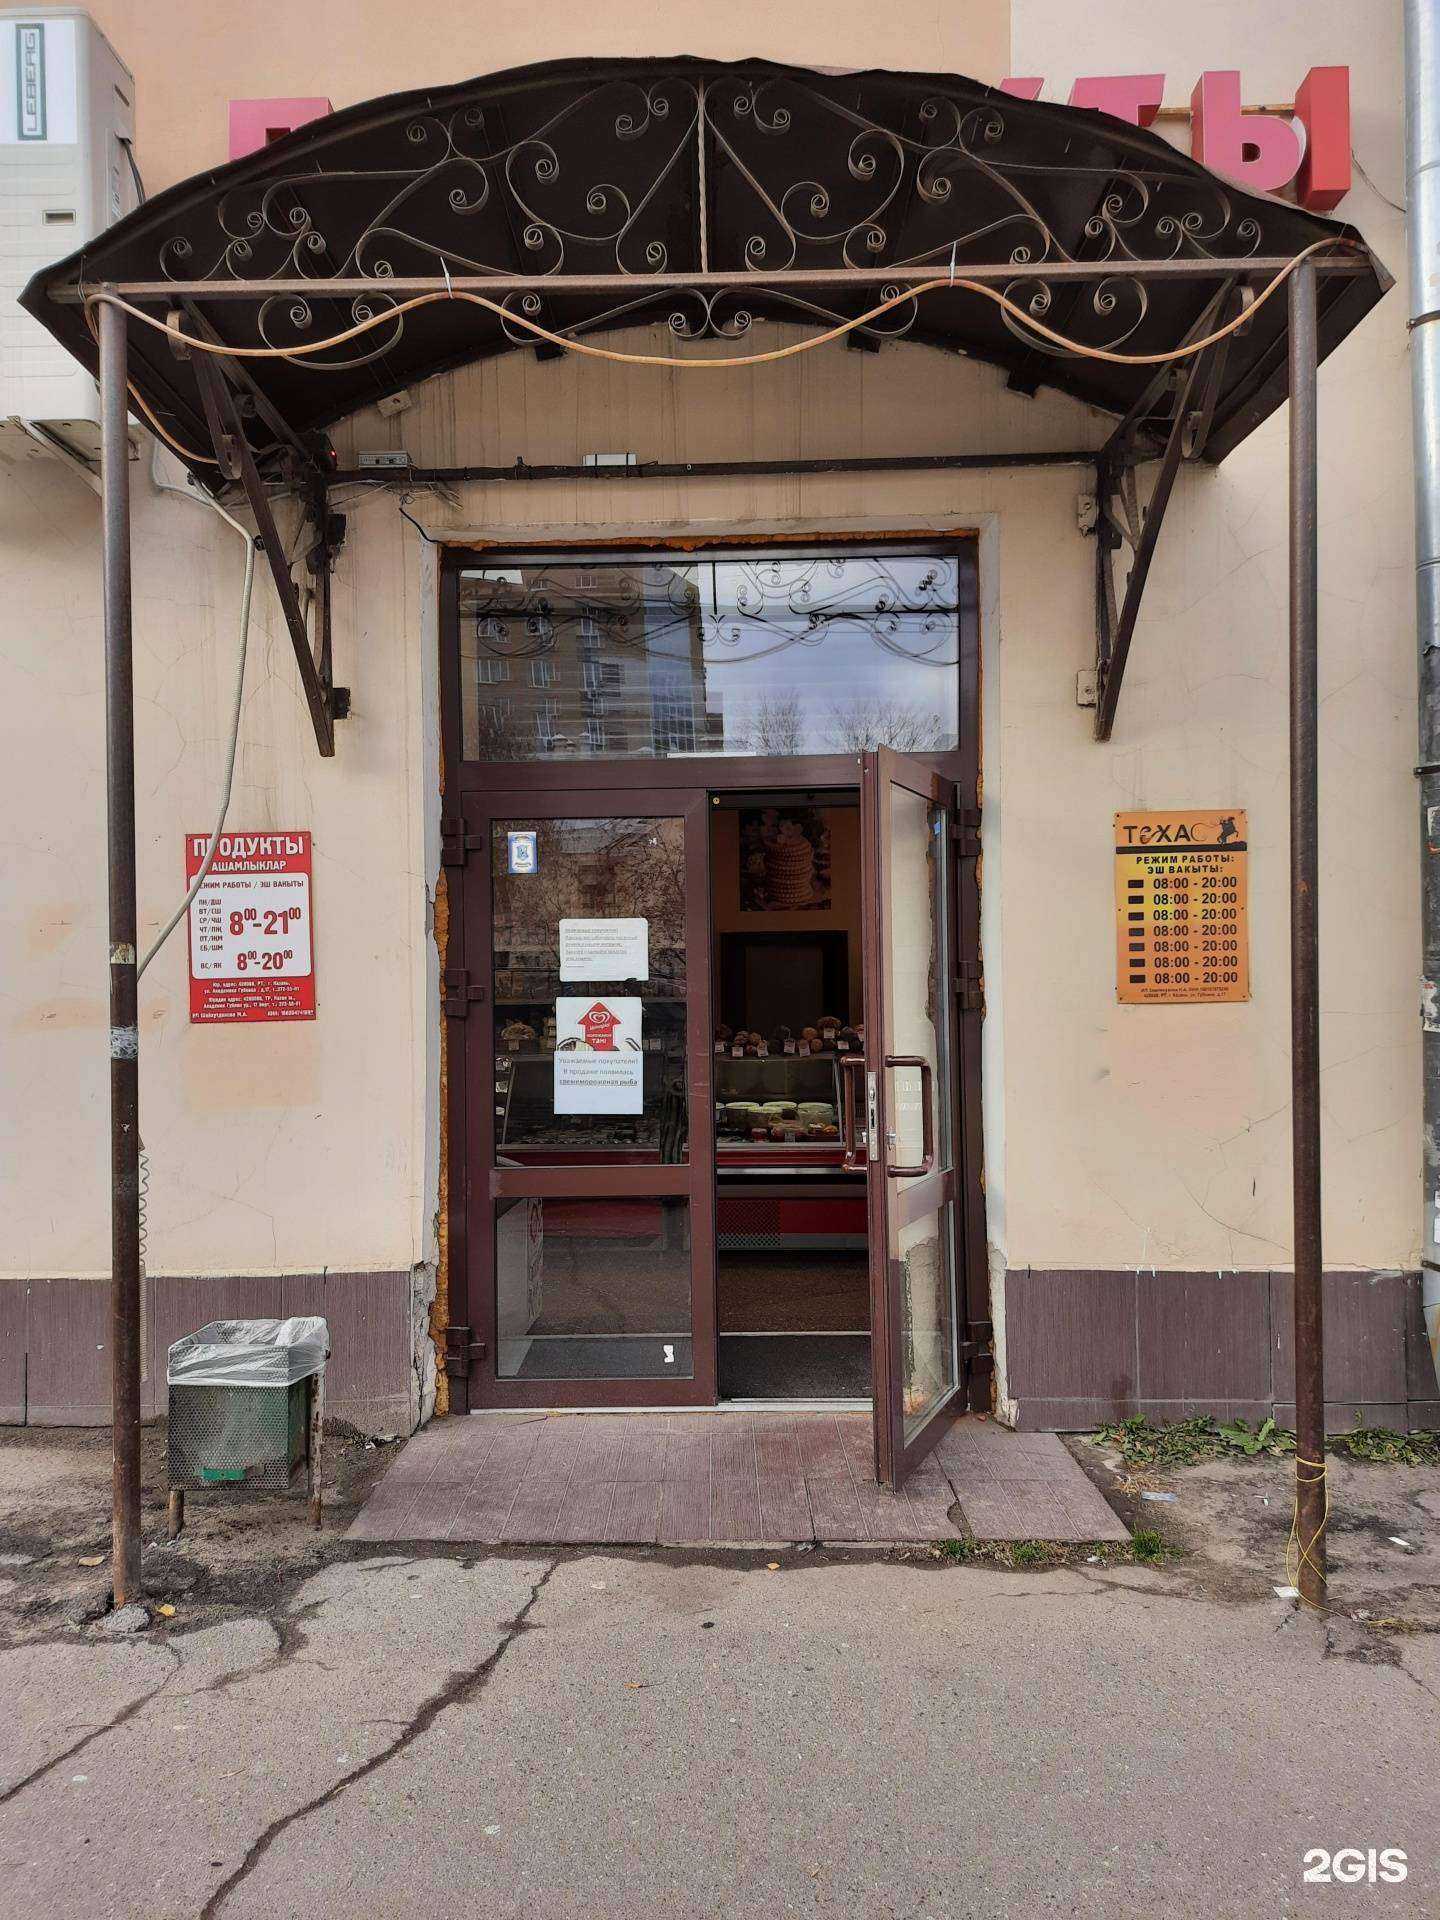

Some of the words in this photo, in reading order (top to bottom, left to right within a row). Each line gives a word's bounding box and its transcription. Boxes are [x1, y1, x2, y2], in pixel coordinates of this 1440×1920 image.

[25, 32, 38, 132] LEBERG
[212, 860, 286, 871] АШАМЛЫКЛАР
[1136, 856, 1177, 864] РЕЖИМ
[1182, 855, 1234, 863] РАБОТЫ:
[1154, 878, 1189, 889] 08:00
[1202, 877, 1237, 888] 20:00
[1154, 894, 1189, 905] 08:00
[1202, 893, 1237, 904] 20:00
[1154, 910, 1188, 921] 08:00
[1202, 909, 1236, 919] 20:00
[1154, 925, 1189, 936] 08:00
[1202, 924, 1237, 935] 20:00
[1154, 941, 1189, 951] 08:00
[1202, 940, 1237, 951] 20:00
[1154, 957, 1189, 968] 08:00
[1202, 956, 1238, 966] 20:00
[1154, 973, 1190, 983] 08:00
[1203, 972, 1238, 983] 20:00
